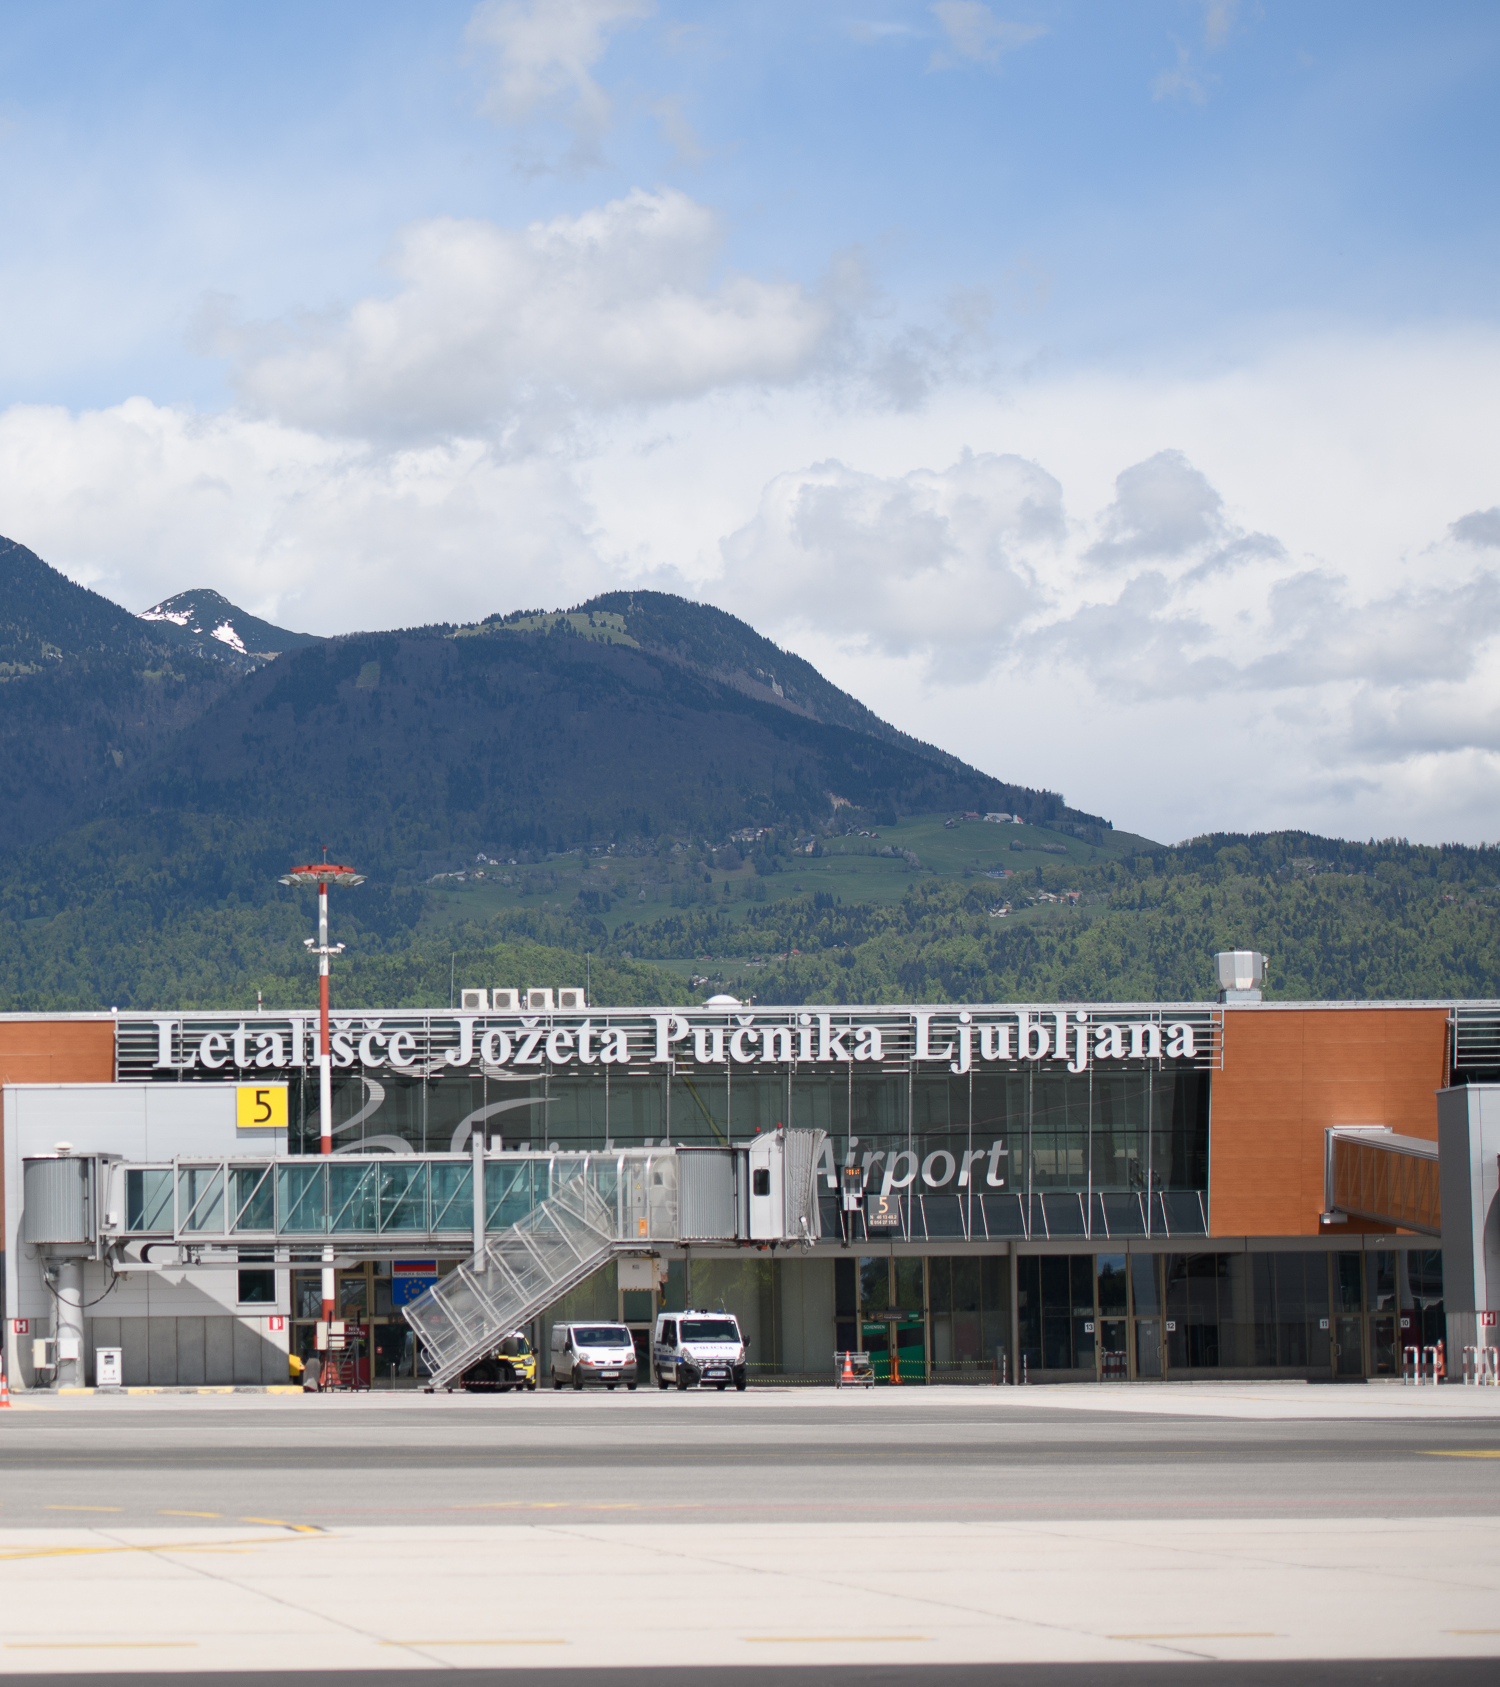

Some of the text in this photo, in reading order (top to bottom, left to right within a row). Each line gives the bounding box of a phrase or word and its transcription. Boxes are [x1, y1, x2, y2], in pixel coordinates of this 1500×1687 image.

[152, 1010, 1198, 1075] Letališče Jožeta Pučnika Ljubljana
[253, 1090, 272, 1123] 5
[816, 1136, 1009, 1196] Airport
[878, 1196, 889, 1214] 5
[16, 1321, 26, 1332] H
[1483, 1313, 1494, 1324] H
